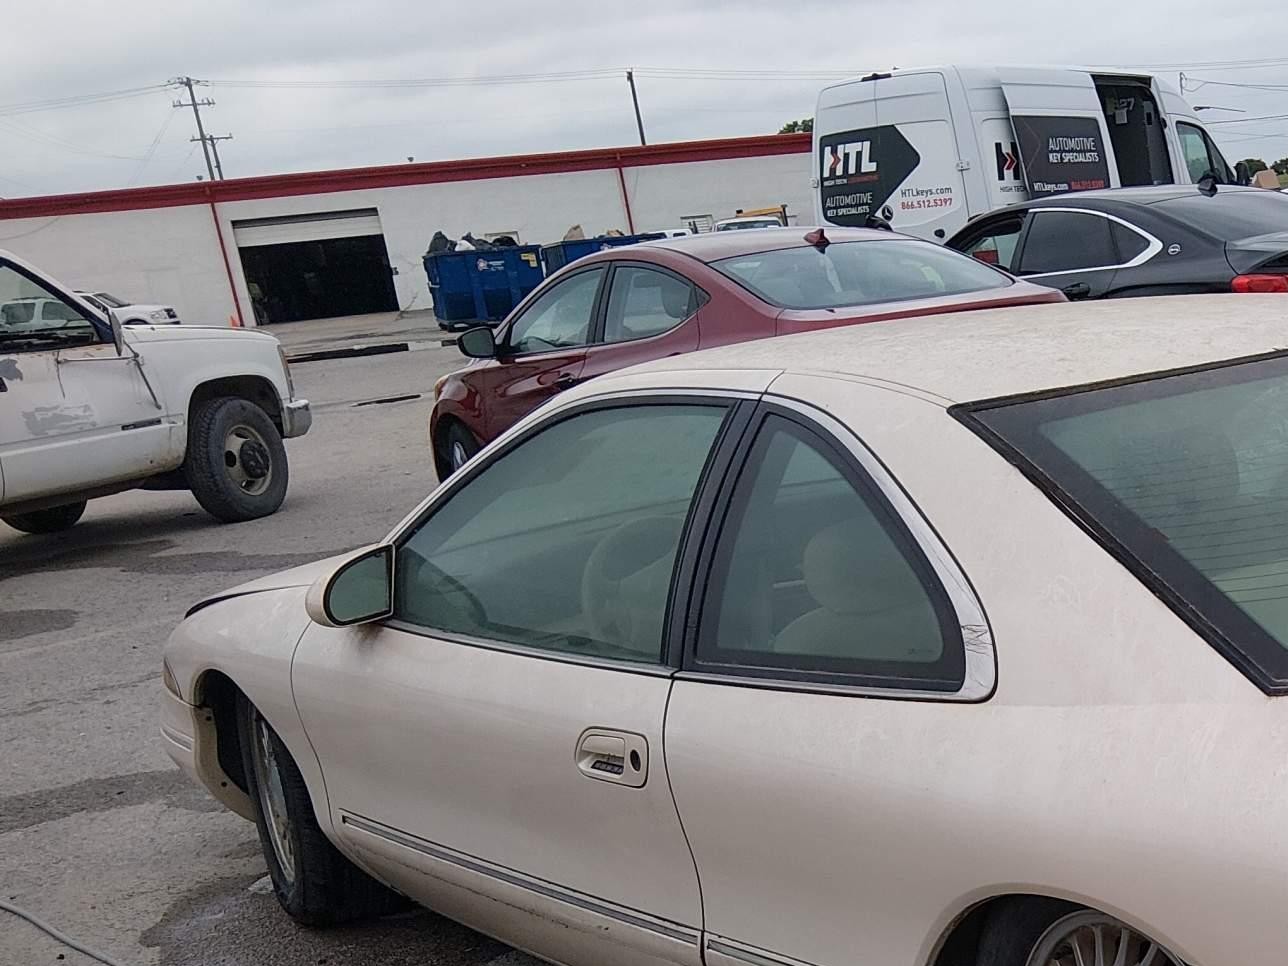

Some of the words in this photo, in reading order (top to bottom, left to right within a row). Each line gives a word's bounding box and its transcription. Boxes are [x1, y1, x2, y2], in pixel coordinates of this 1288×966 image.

[1048, 137, 1096, 151] AUTOMOTIVE
[823, 140, 878, 178] HTL
[1049, 153, 1061, 163] KEY
[1061, 152, 1099, 163] SPECIALISTS
[901, 186, 953, 198] HTLkeys.com
[1033, 182, 1069, 192] HTLkeys.com
[825, 192, 873, 208] AUTOMOTIVE
[901, 198, 953, 210] 866.512.5397
[827, 209, 837, 217] KEY
[837, 205, 870, 216] SPECIALISTS
